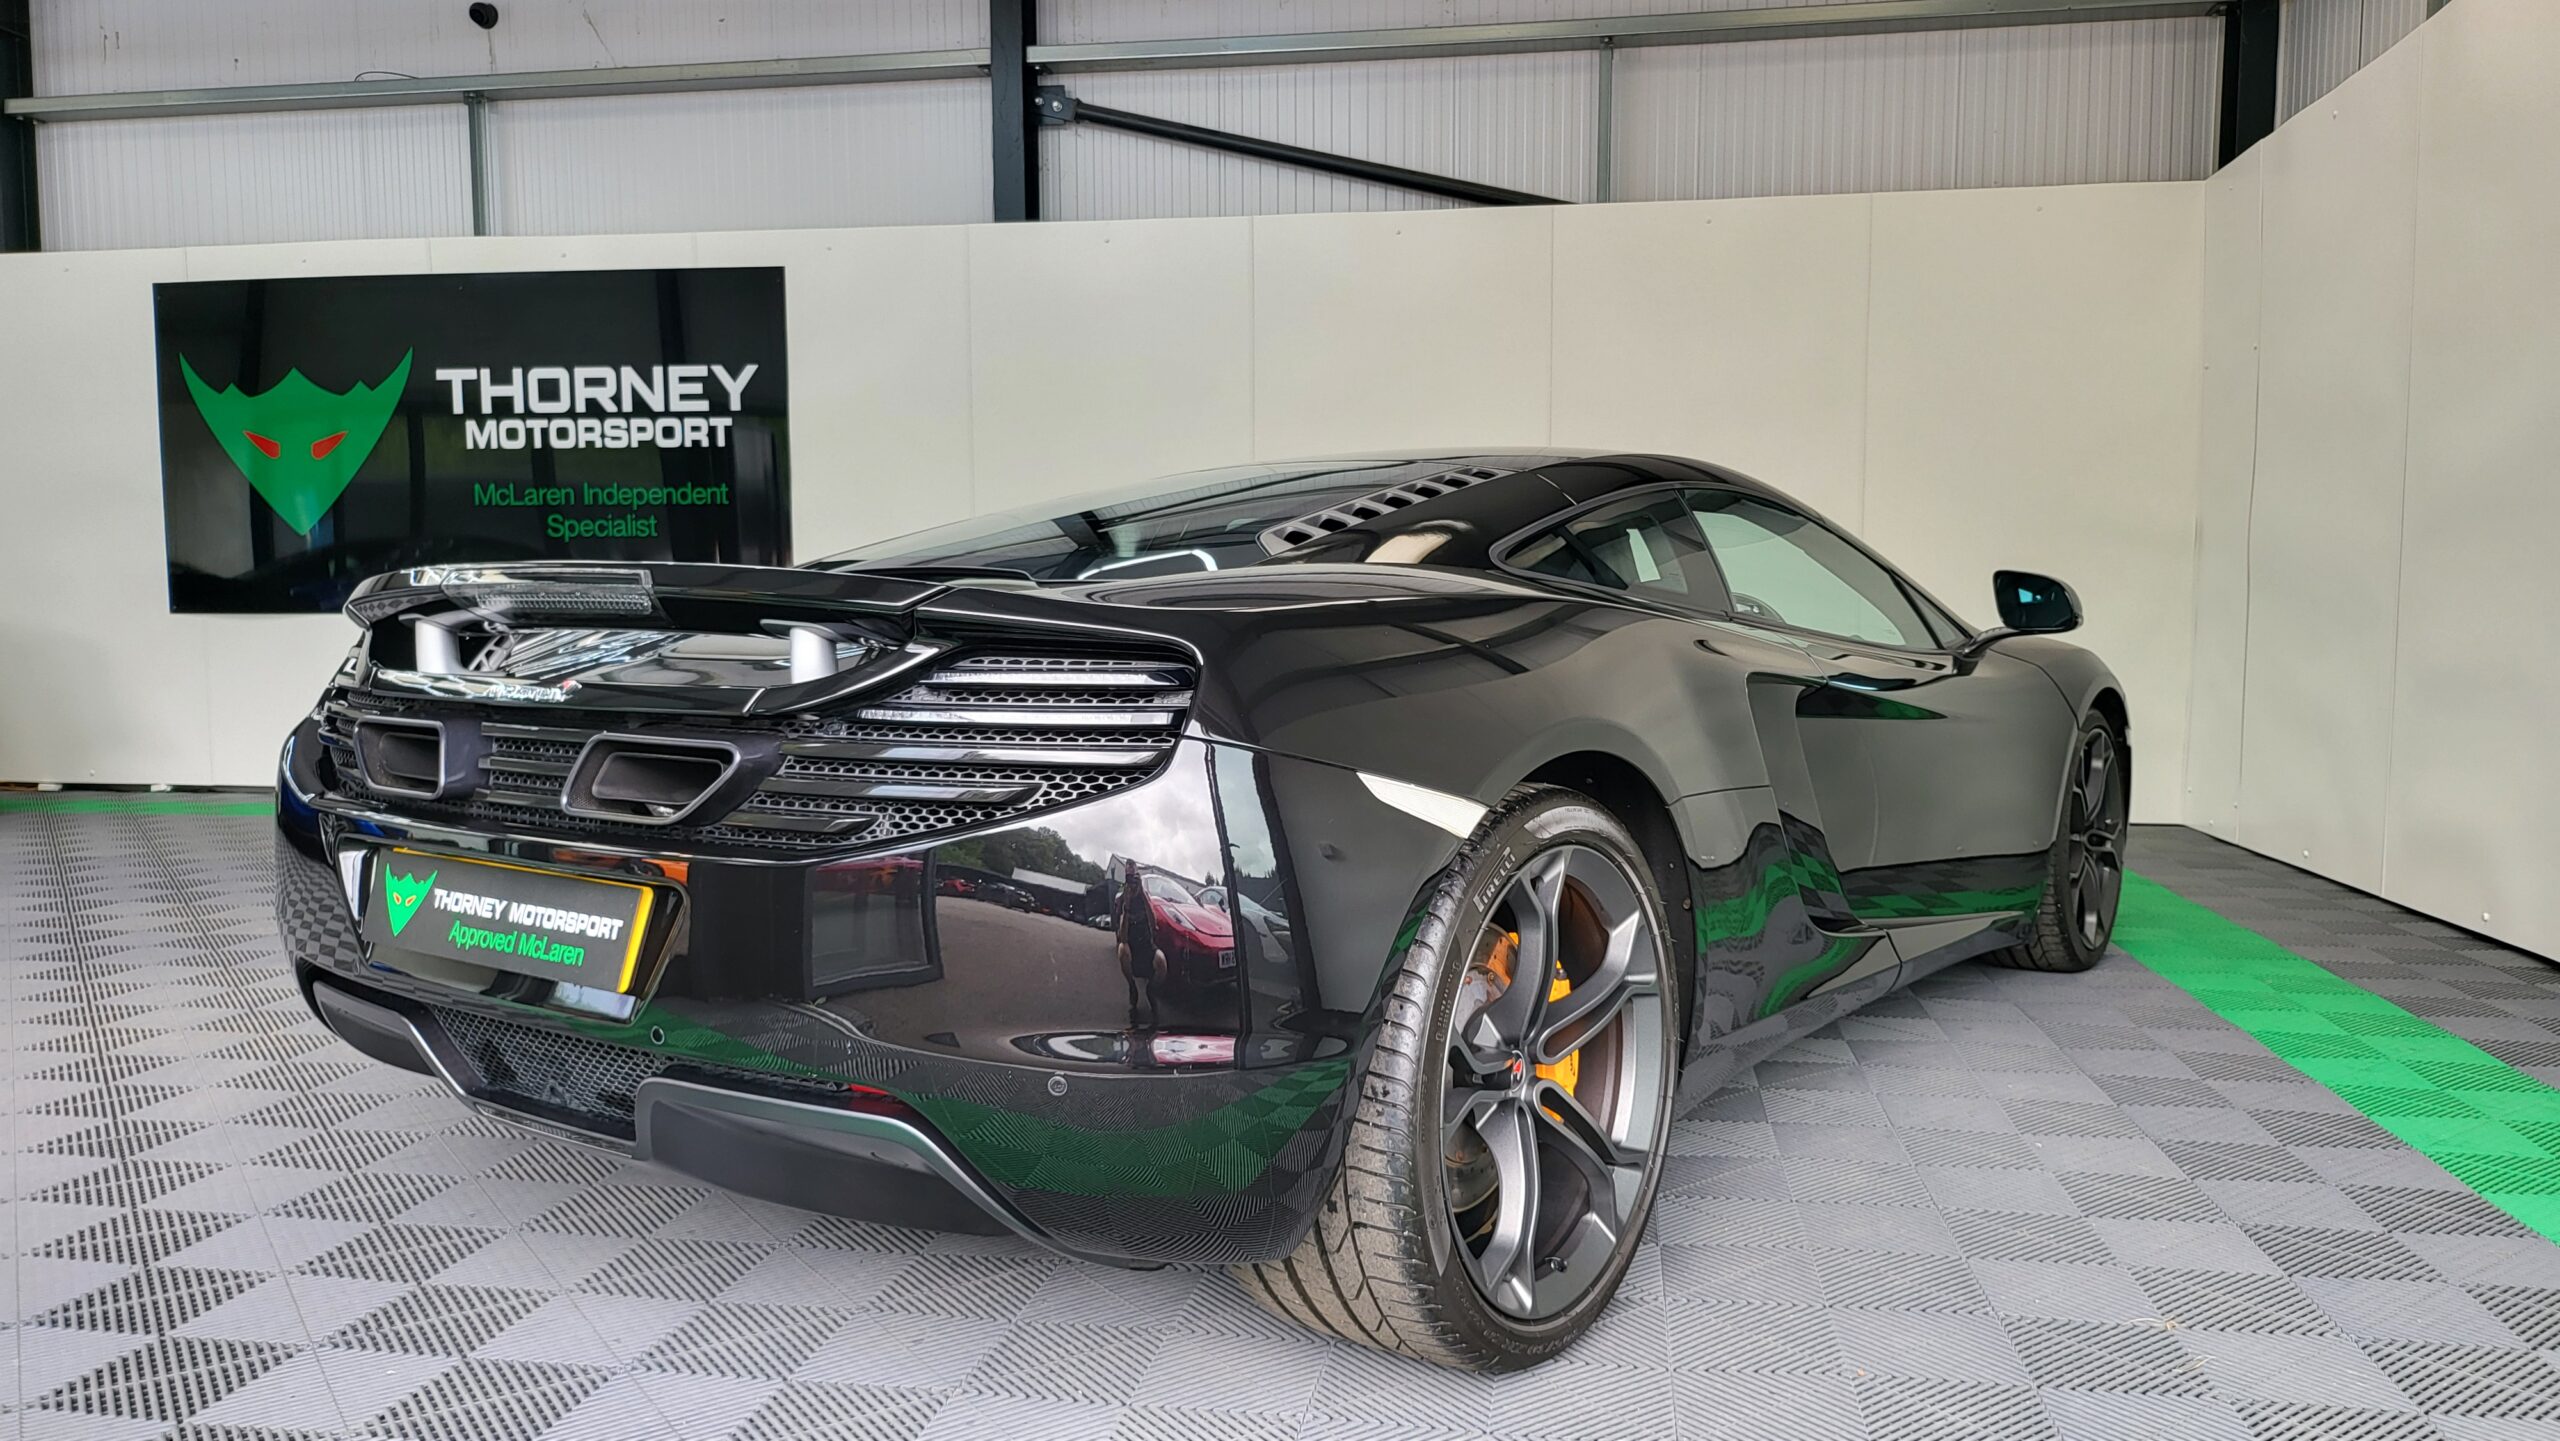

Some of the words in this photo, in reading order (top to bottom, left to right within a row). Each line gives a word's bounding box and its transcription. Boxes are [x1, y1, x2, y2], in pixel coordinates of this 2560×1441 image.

[435, 364, 759, 415] THORNEY
[465, 417, 733, 450] MOTORSPORT
[473, 481, 575, 507] McLaren
[582, 481, 729, 511] Independent
[546, 512, 658, 543] Specialist
[1473, 846, 1516, 913] PIRELLI
[434, 887, 508, 921] THORNEY
[508, 901, 625, 941] MOTORSPORT
[448, 919, 518, 950] Approved
[517, 932, 585, 967] McLaren
